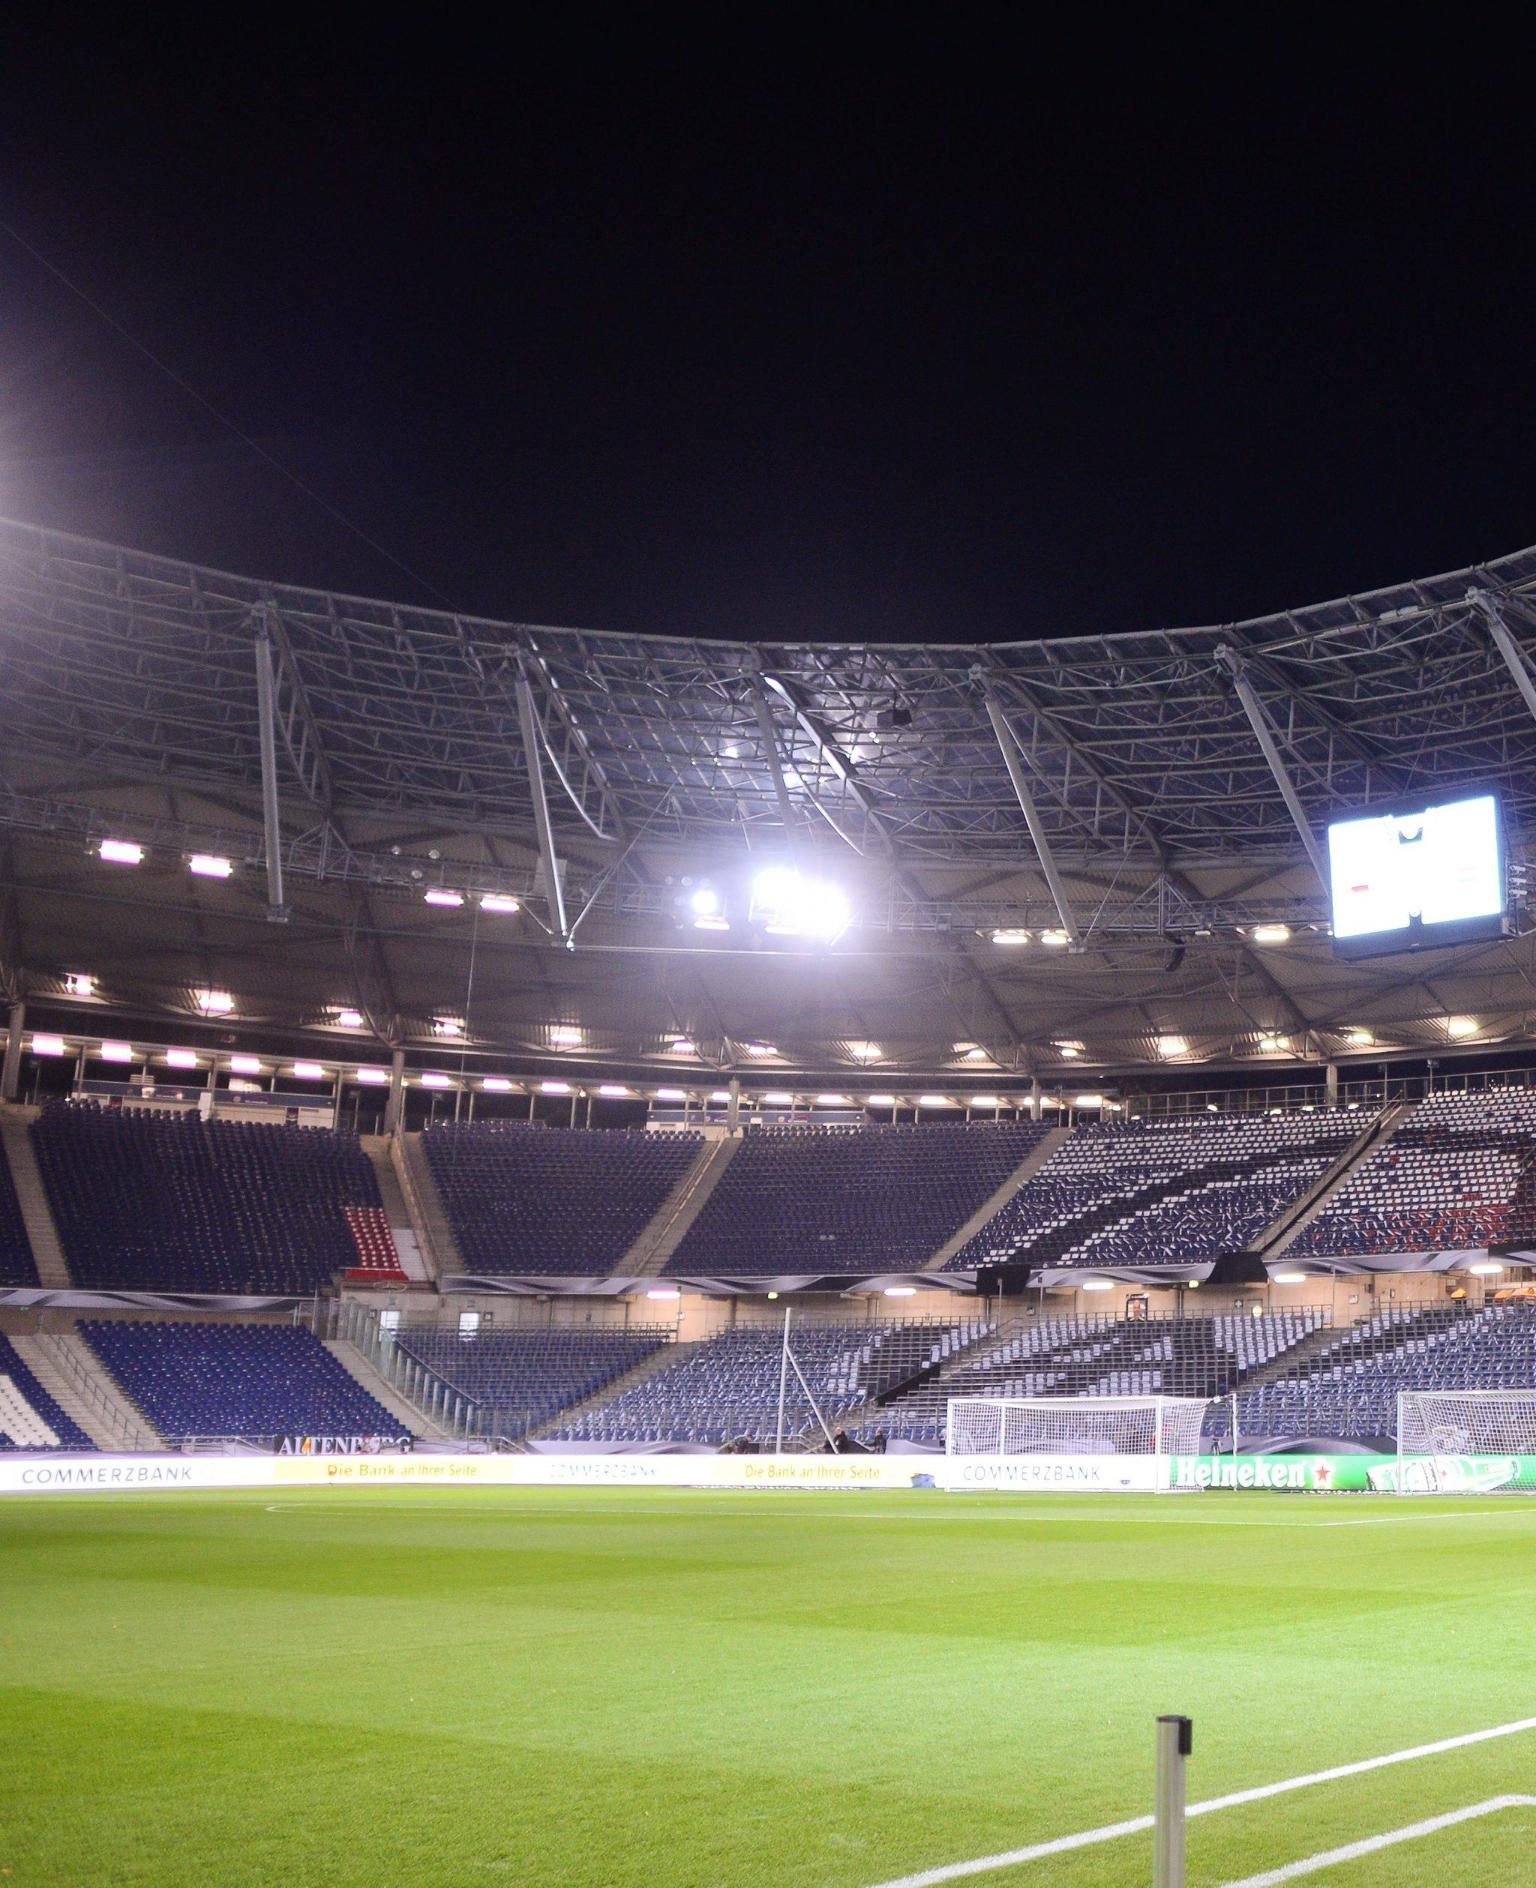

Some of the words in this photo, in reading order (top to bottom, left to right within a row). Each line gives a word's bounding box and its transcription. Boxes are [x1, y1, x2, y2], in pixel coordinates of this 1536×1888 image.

[22, 1466, 193, 1484] COMMERZBANK
[327, 1464, 353, 1477] Die
[359, 1464, 395, 1477] Bank
[401, 1466, 414, 1476] an
[418, 1464, 445, 1476] Ihrer
[449, 1464, 478, 1476] Seite
[745, 1464, 763, 1479] Die
[768, 1465, 796, 1478] Bank
[800, 1468, 813, 1478] an
[817, 1465, 846, 1478] Ihrer
[850, 1465, 880, 1479] Seite
[963, 1465, 1101, 1481] COMMERZBANK
[1176, 1456, 1306, 1488] Heineken
